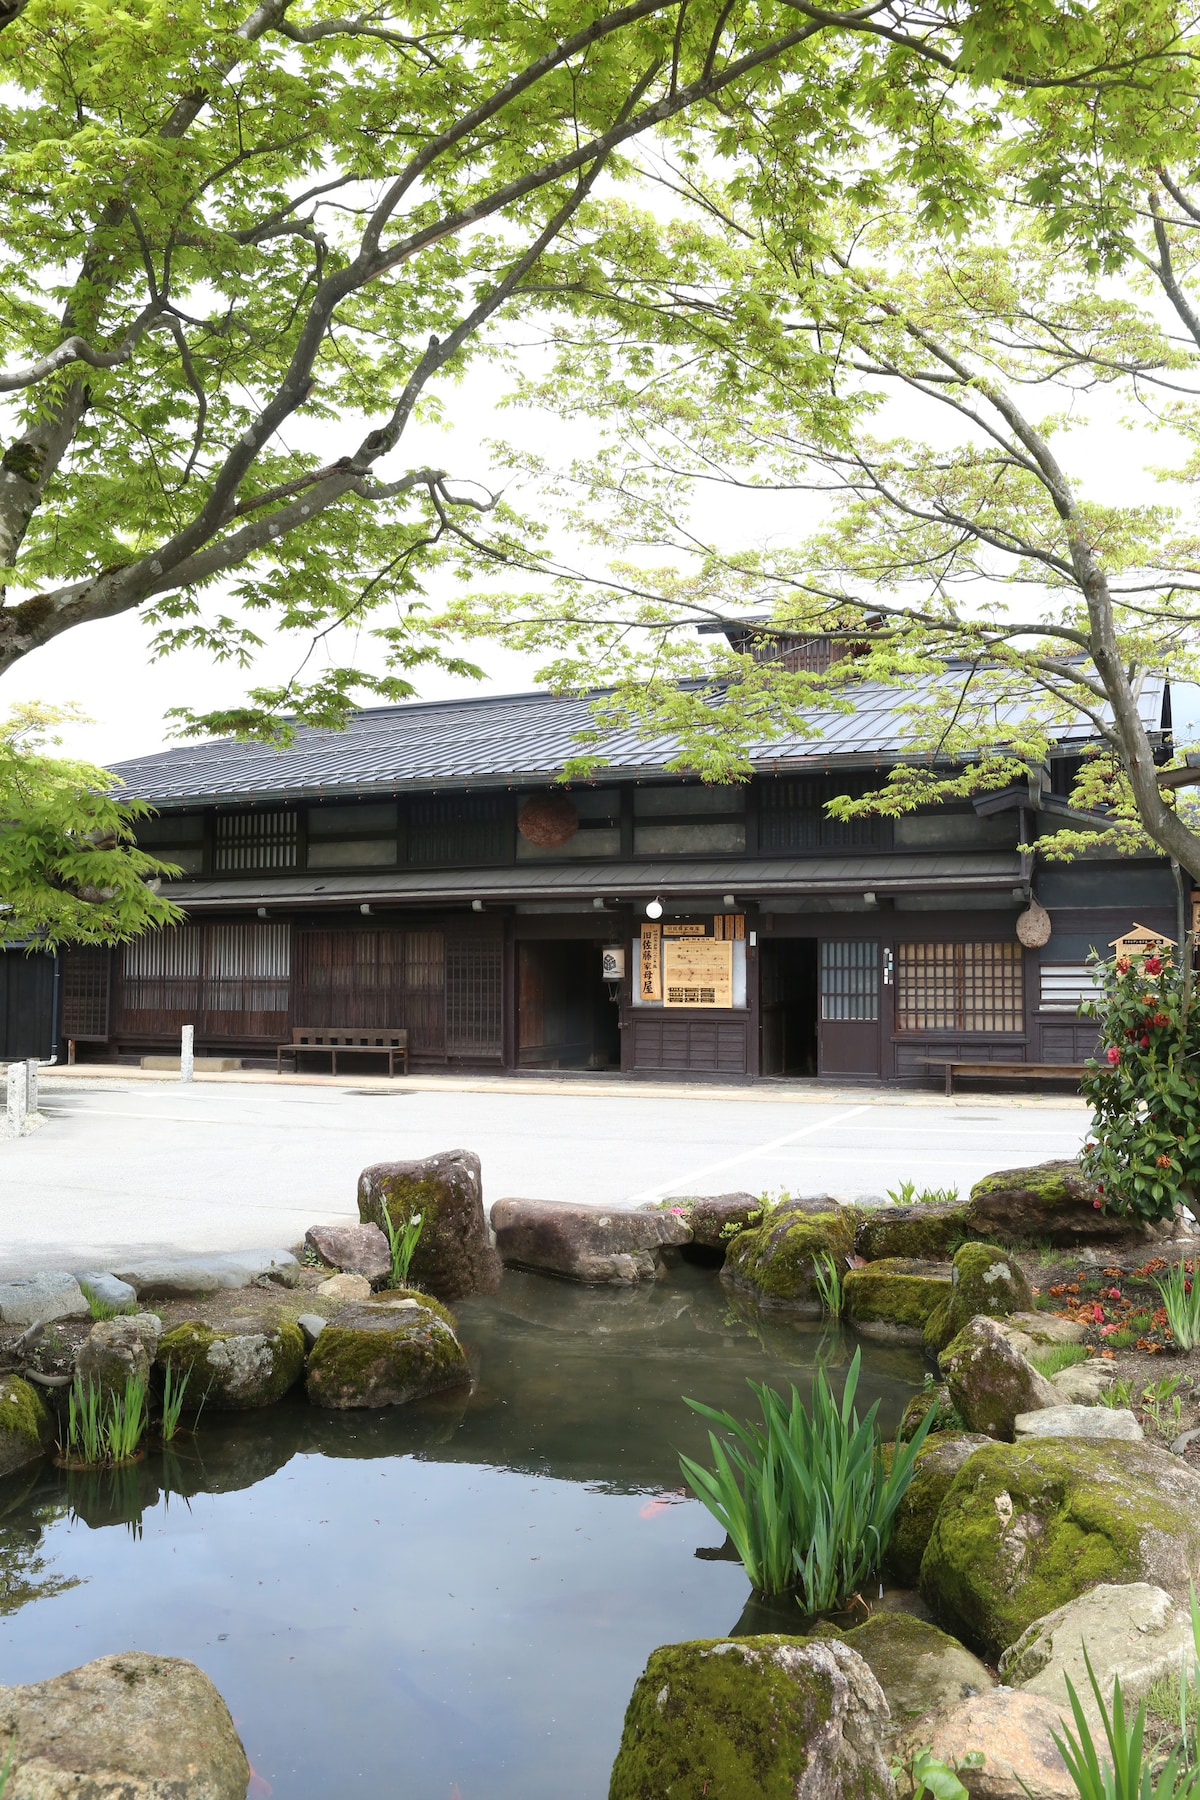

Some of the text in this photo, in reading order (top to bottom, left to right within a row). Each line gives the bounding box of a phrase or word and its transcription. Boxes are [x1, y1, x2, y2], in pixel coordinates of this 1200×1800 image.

[643, 932, 653, 993] 旧佐藤家母屋
